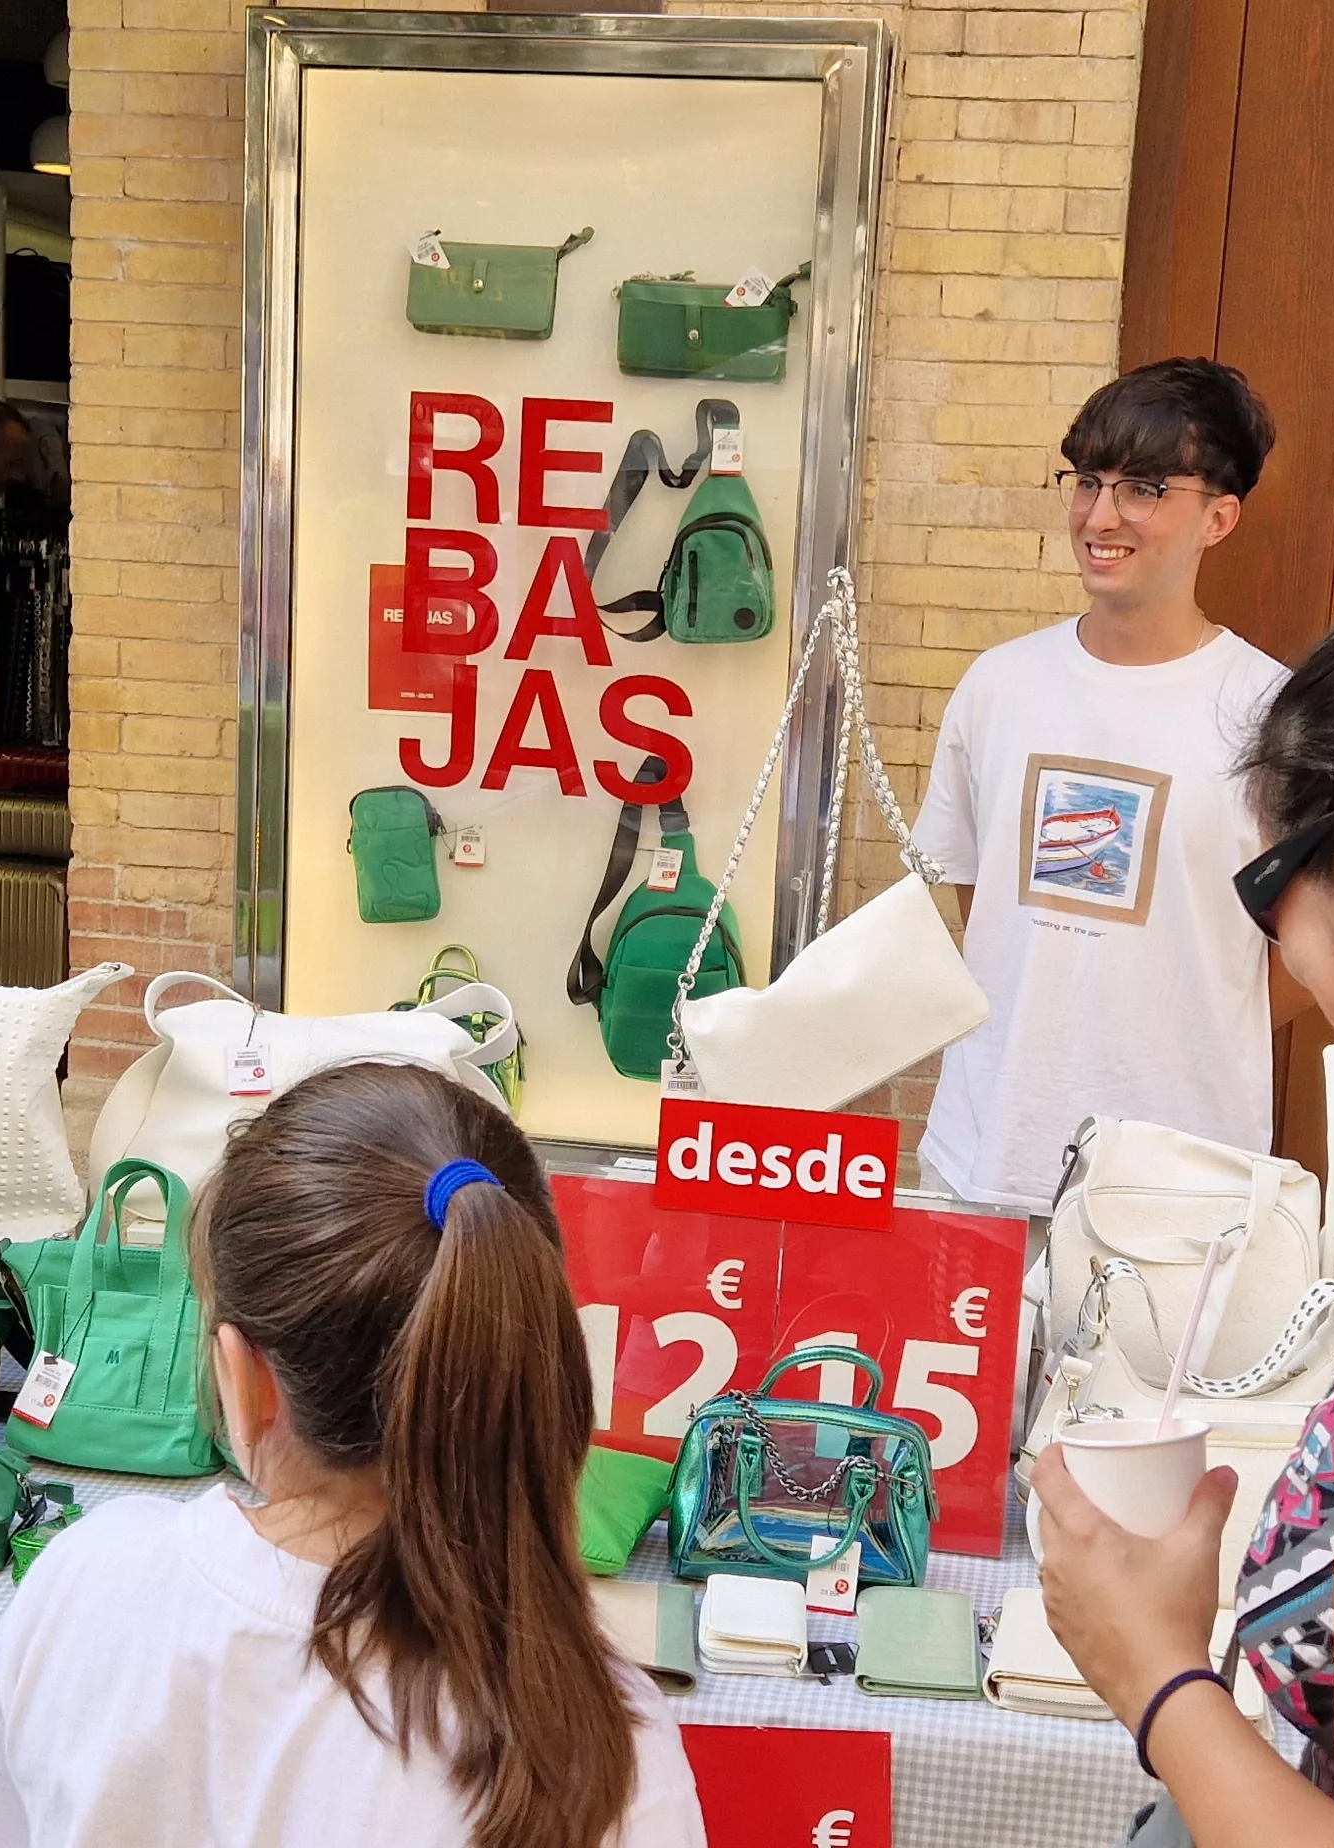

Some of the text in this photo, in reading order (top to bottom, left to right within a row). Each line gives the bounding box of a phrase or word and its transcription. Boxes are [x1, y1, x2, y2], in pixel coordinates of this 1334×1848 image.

[406, 391, 613, 532] RE
[383, 608, 453, 625] REJAS
[402, 527, 613, 667] BA
[398, 664, 693, 805] JAS
[667, 1121, 887, 1199] desde
[576, 1259, 746, 1439] 12 €
[794, 1286, 991, 1470] 15 €
